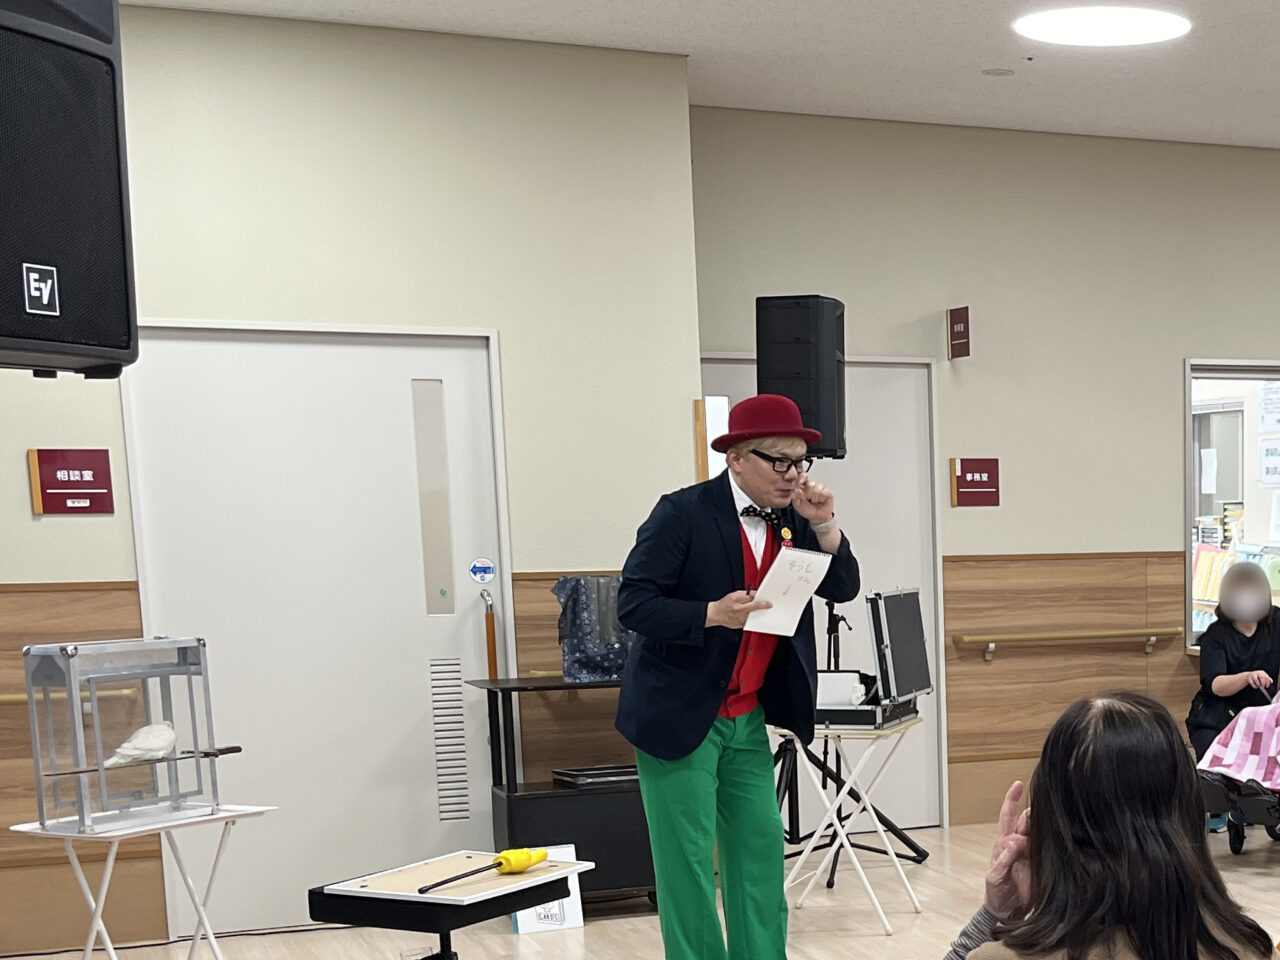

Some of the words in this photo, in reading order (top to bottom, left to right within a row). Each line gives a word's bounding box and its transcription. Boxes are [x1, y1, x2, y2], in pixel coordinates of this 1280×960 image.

[56, 470, 94, 481] 相談室
[965, 473, 989, 482] 事務室
